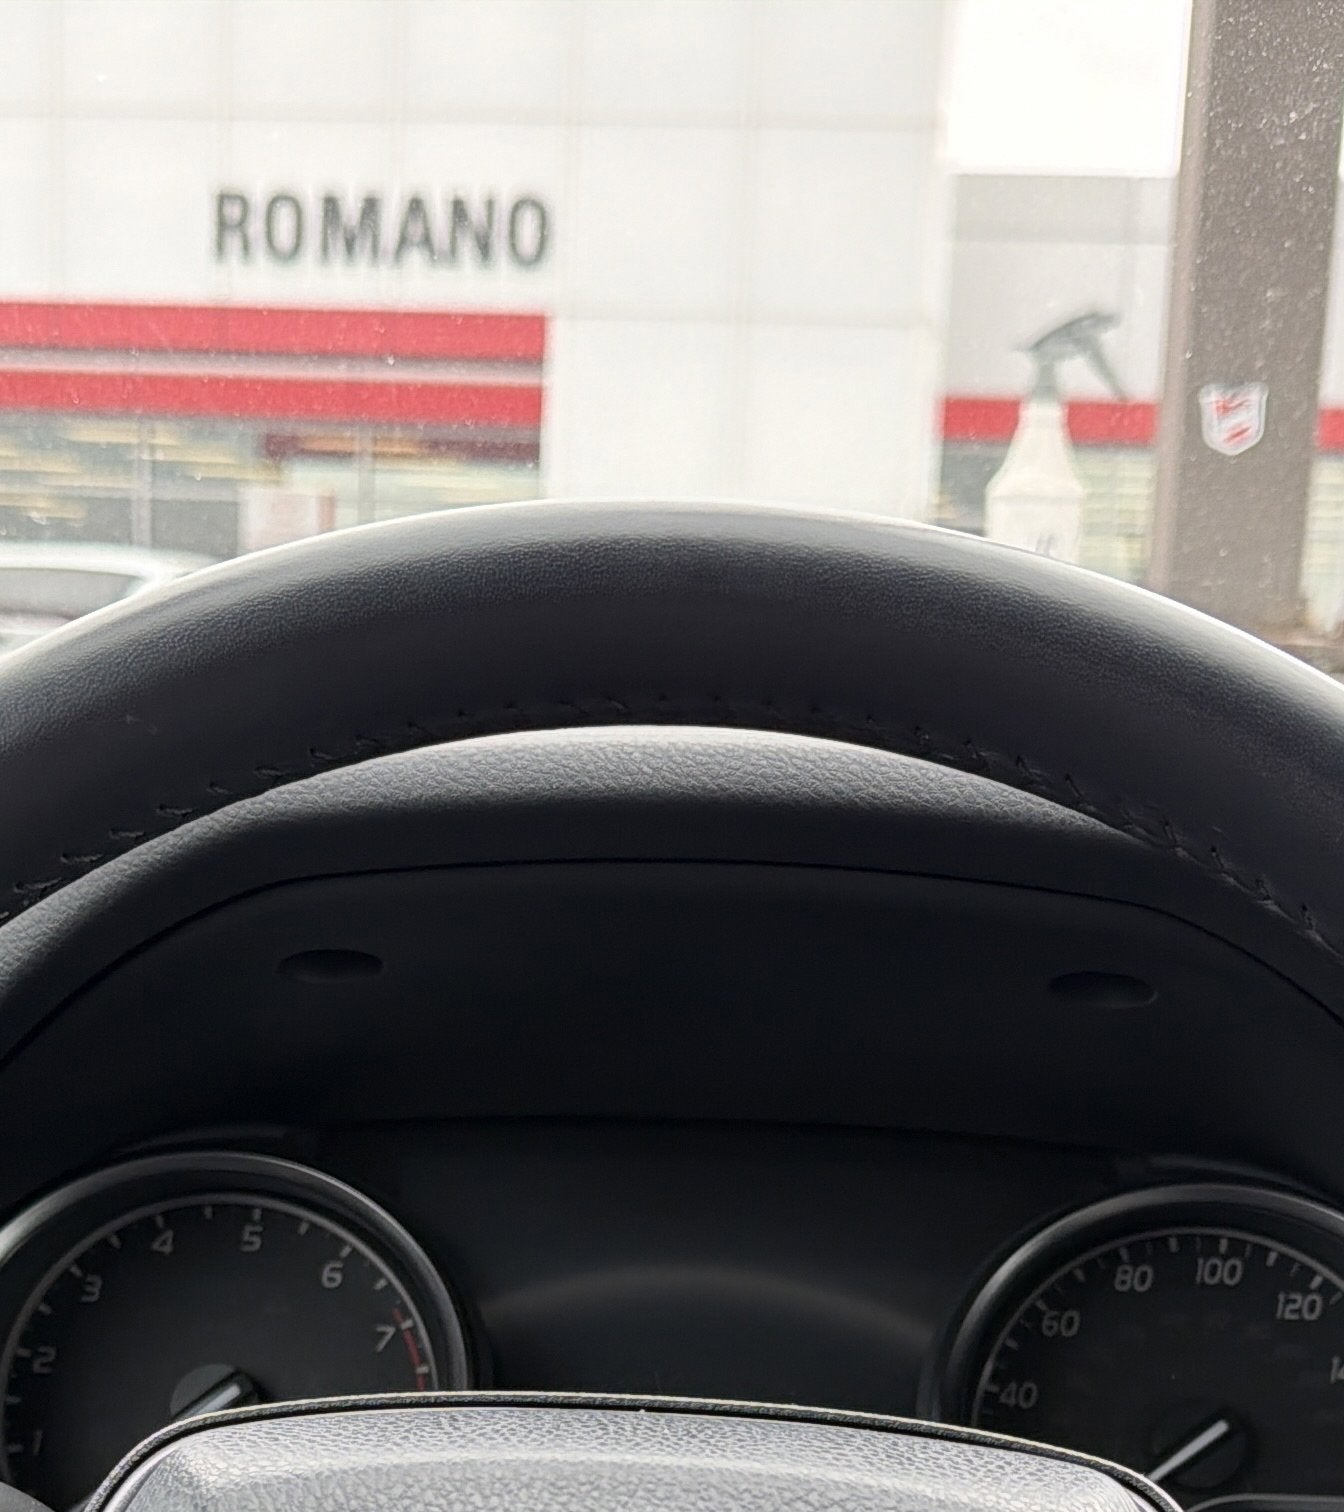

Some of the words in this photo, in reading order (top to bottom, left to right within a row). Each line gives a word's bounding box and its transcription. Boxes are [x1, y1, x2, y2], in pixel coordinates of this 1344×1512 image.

[214, 188, 552, 268] ROMANO
[150, 1228, 175, 1256] 4
[240, 1223, 263, 1252] 5
[320, 1261, 344, 1290] 6
[1113, 1263, 1155, 1293] 80
[1195, 1257, 1243, 1286] 100
[81, 1274, 103, 1303] 3
[1276, 1292, 1324, 1322] 120
[1041, 1308, 1081, 1339] 60
[374, 1324, 397, 1354] 7
[31, 1346, 57, 1375] 2
[998, 1381, 1039, 1411] 40
[31, 1428, 43, 1456] 1
